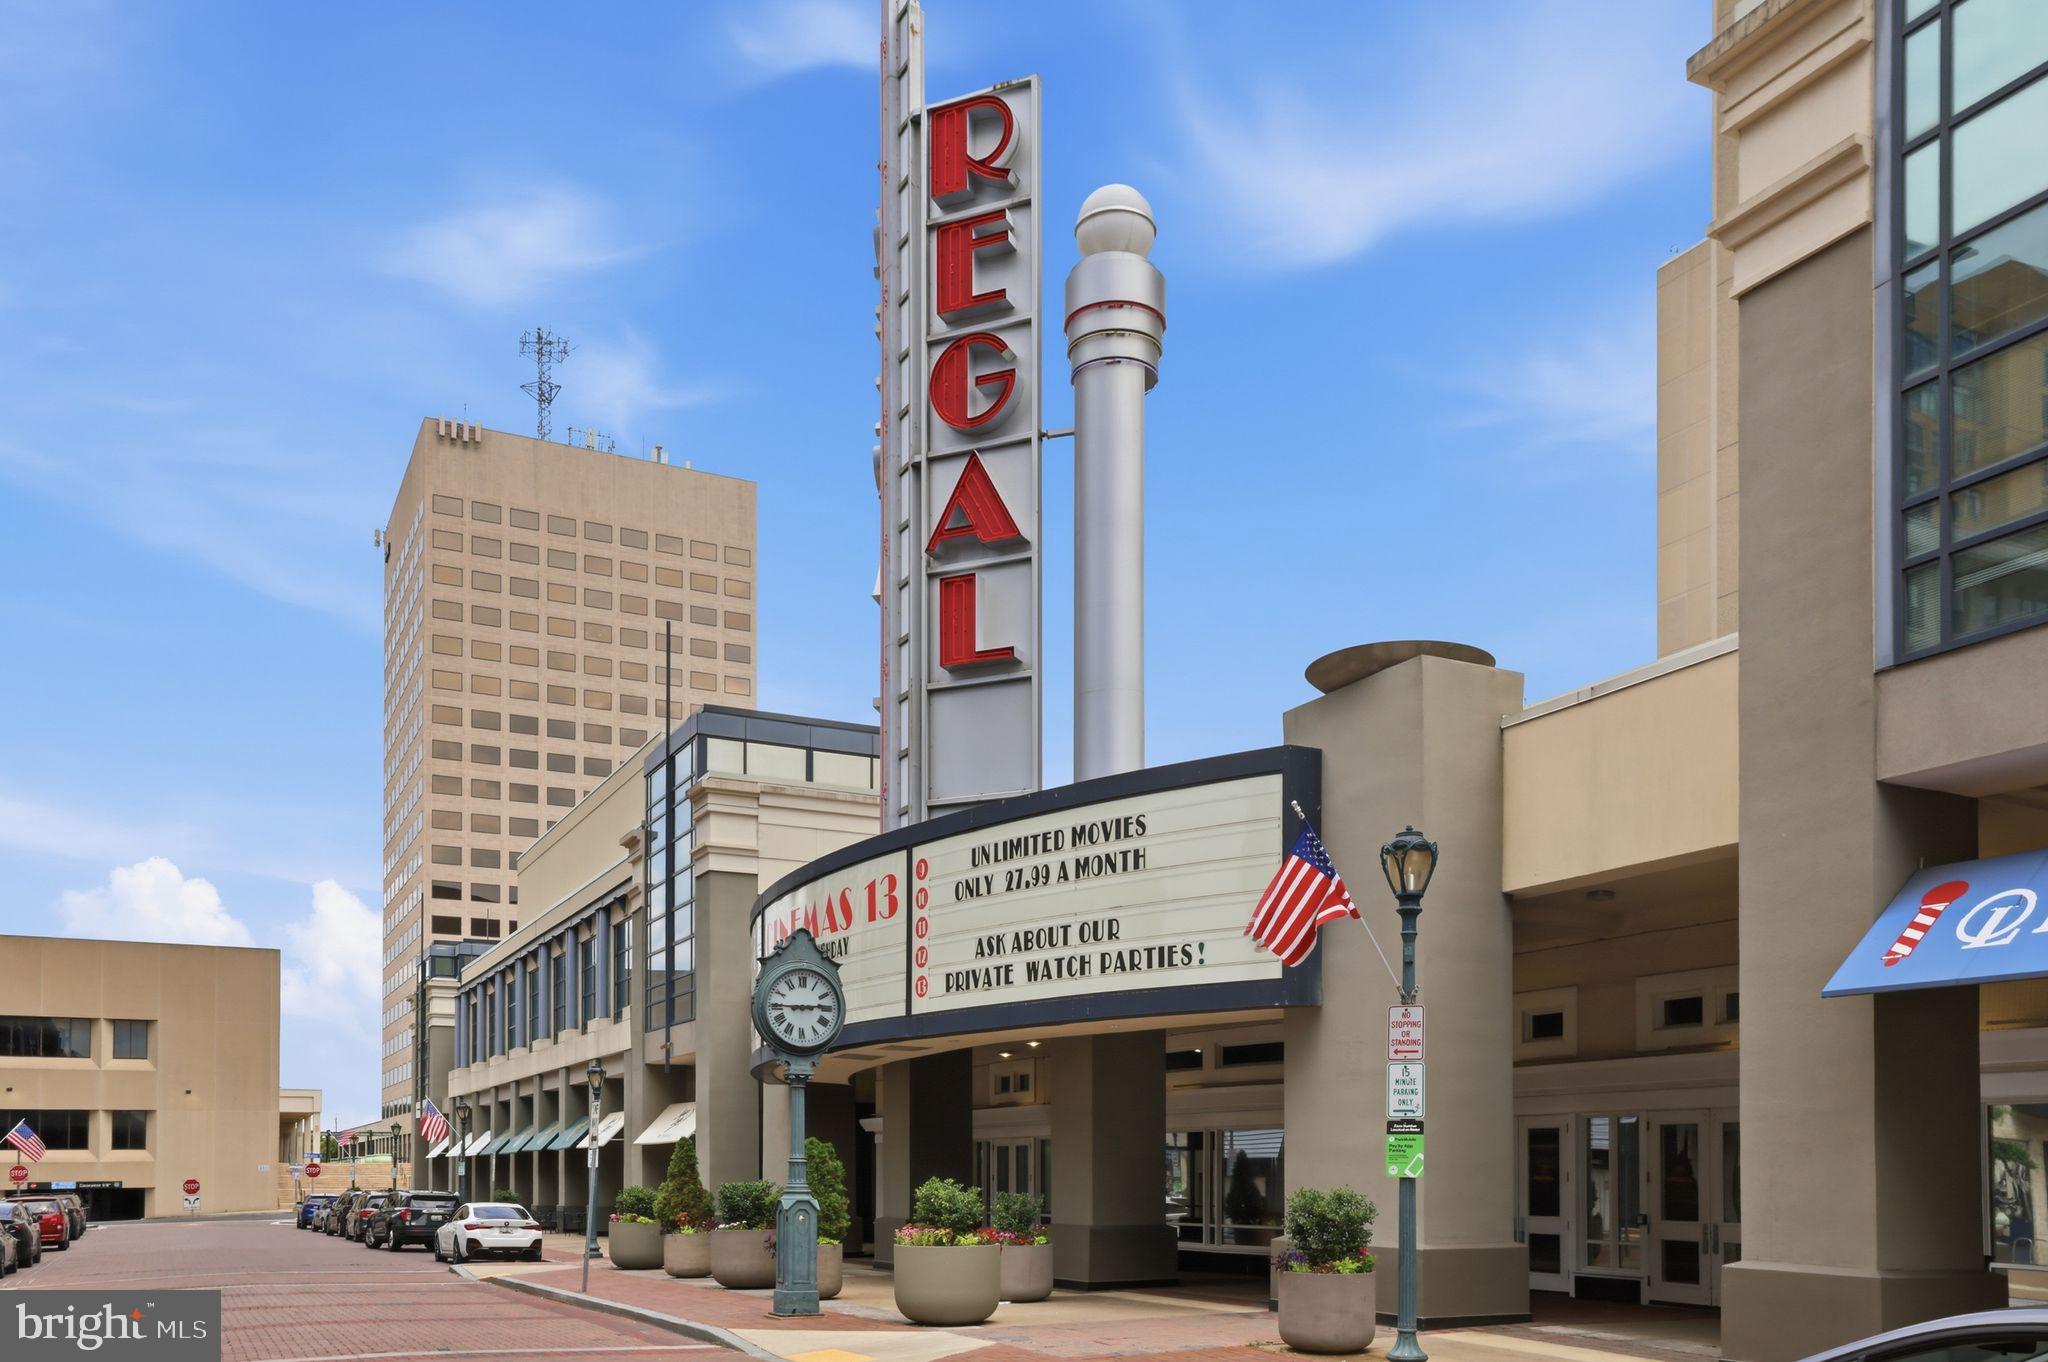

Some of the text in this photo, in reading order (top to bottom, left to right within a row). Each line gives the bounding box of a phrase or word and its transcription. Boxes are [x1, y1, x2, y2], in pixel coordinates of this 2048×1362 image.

[925, 95, 1031, 671] REGAL
[971, 814, 1147, 868] UNLIMITED MOVIES
[955, 847, 1146, 901] ONLY 27.99 A MONTH
[863, 873, 899, 923] 13
[975, 918, 1120, 959] ASK ABOUT OUR
[945, 942, 1206, 993] PRIVATE WATCH PARTIES!
[1402, 1011, 1411, 1019] NO
[1391, 1020, 1421, 1029] STOPPING
[1401, 1030, 1411, 1038] OR
[1390, 1039, 1421, 1047] STANDING
[1402, 1067, 1411, 1077] 15
[1394, 1078, 1417, 1086] MINUTE
[1393, 1088, 1419, 1096] PARKING
[1397, 1098, 1413, 1106] ONLY
[10, 1169, 28, 1177] STOP
[183, 1182, 199, 1191] STOP
